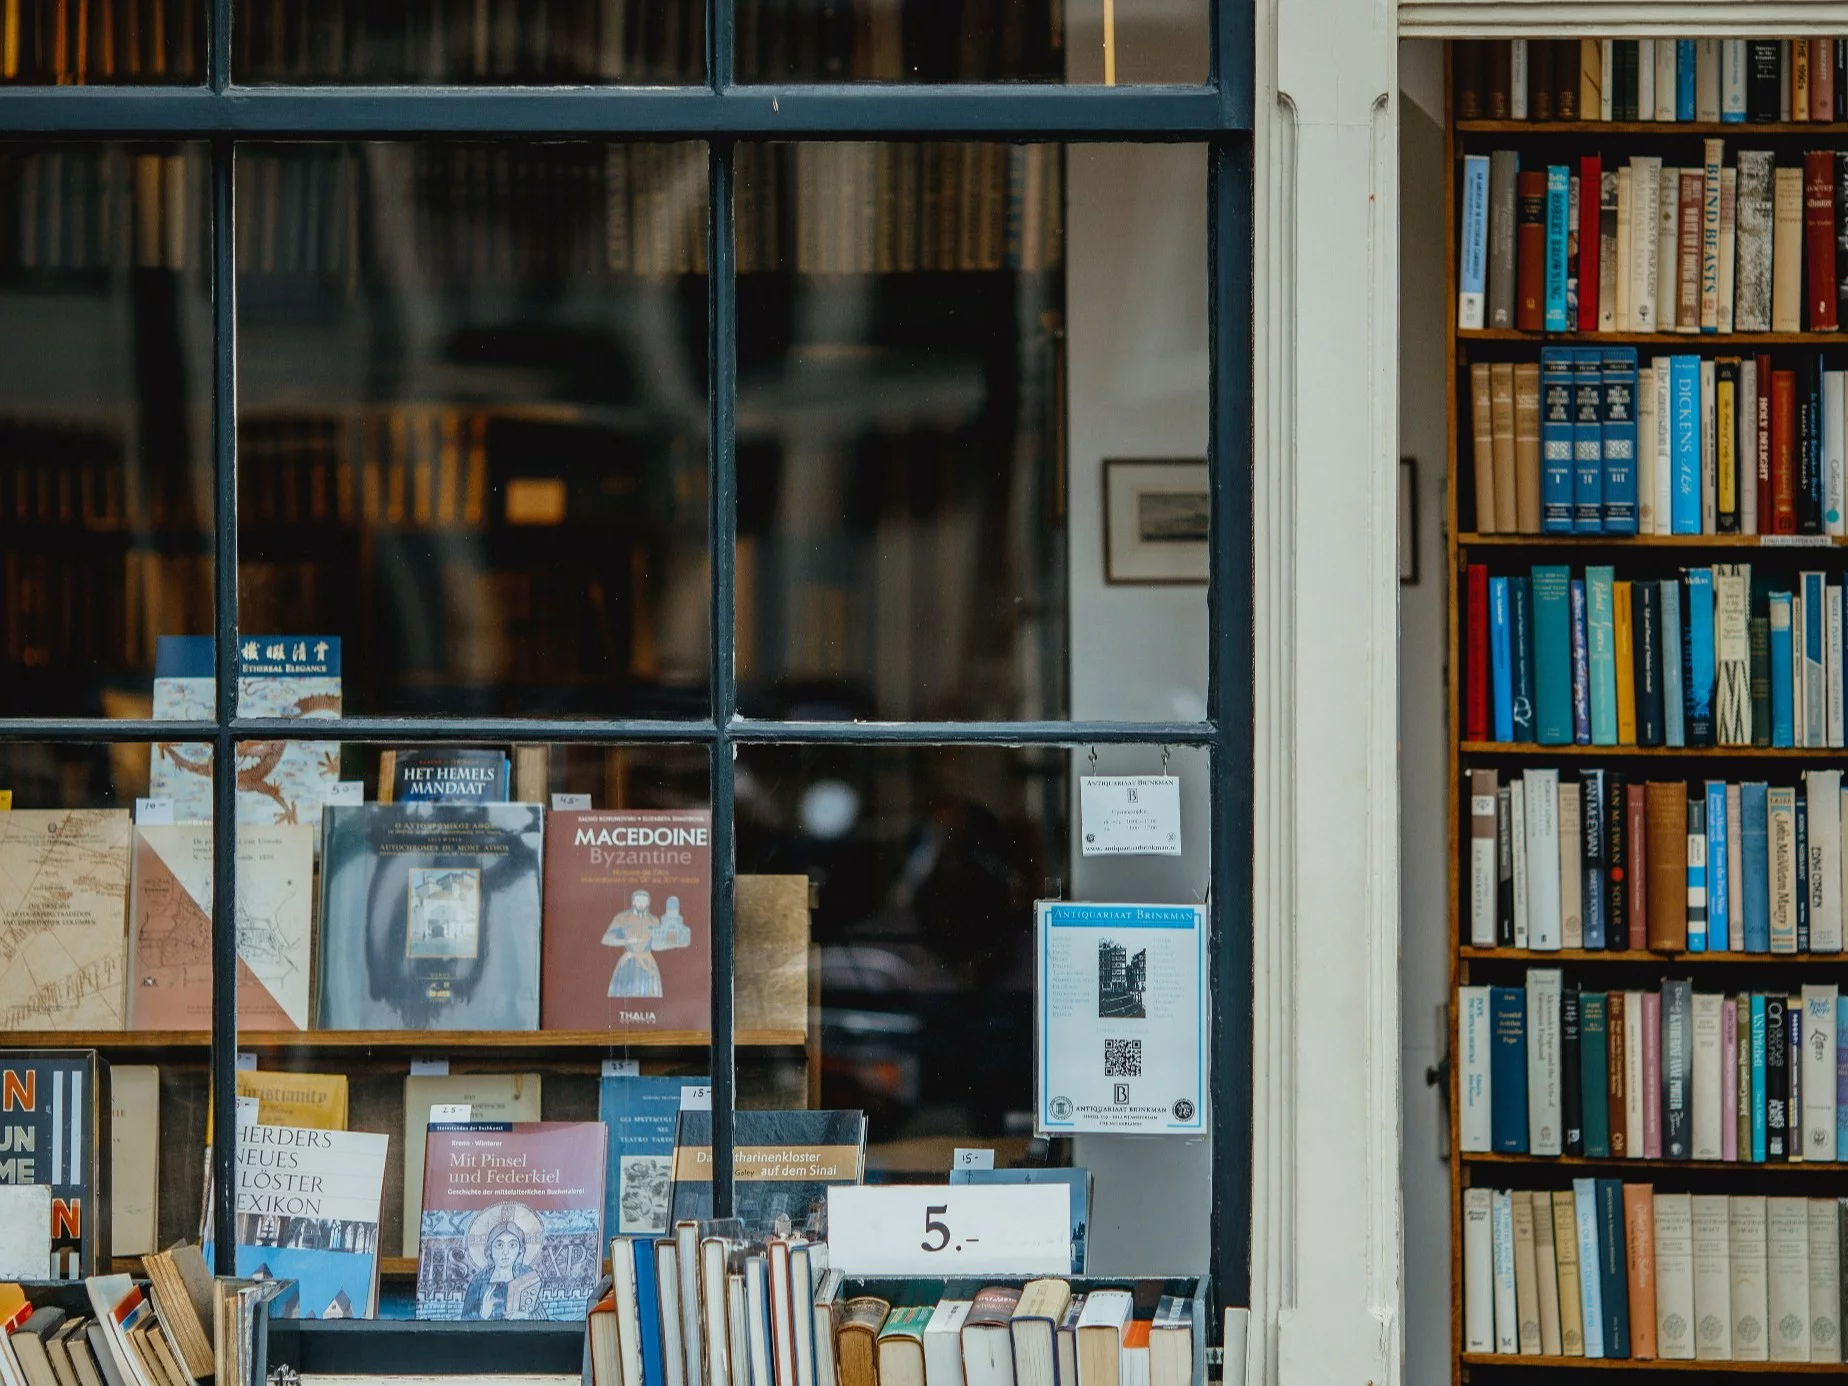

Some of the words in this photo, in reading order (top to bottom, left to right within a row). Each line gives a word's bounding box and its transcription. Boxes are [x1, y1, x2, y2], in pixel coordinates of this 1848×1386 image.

[1706, 163, 1718, 223] BLIND
[1704, 229, 1718, 294] BEASTS
[1680, 379, 1692, 453] DICKENS
[1759, 397, 1768, 429] HOLY
[1759, 431, 1768, 481] DELIGHT
[1555, 475, 1561, 483] I
[1583, 475, 1592, 484] II
[1612, 473, 1625, 483] III
[404, 767, 434, 781] HET
[437, 767, 495, 781] HEMELS
[410, 782, 487, 795] MANDAAT
[1587, 779, 1597, 800] IAN
[1611, 783, 1620, 805] IAN
[574, 827, 708, 846] MACEDOINE
[590, 847, 692, 868] Byzantine
[1613, 886, 1621, 924] SOLAR
[1054, 908, 1132, 919] ANTIQUARIAAT
[1137, 908, 1194, 921] BRINKMAN
[619, 1011, 656, 1020] THALIA
[1768, 1002, 1782, 1028] on
[1753, 1030, 1765, 1067] Pritchett
[1116, 1085, 1127, 1103] B
[1075, 1105, 1127, 1113] ANTIQUARIAAT
[1129, 1105, 1167, 1113] BRINKMAN
[449, 1152, 477, 1168] Mit
[481, 1152, 527, 1168] Pinsel
[449, 1169, 481, 1184] und
[486, 1169, 560, 1184] Federkiel
[735, 1169, 755, 1178] Galey
[761, 1164, 780, 1176] auf
[782, 1164, 807, 1176] dem
[809, 1164, 837, 1176] Sinai
[447, 1188, 482, 1196] Geschichte
[483, 1188, 493, 1196] der
[494, 1188, 545, 1196] mittelalterlichen
[547, 1187, 585, 1196] Buchmalerei
[52, 1198, 81, 1239] N
